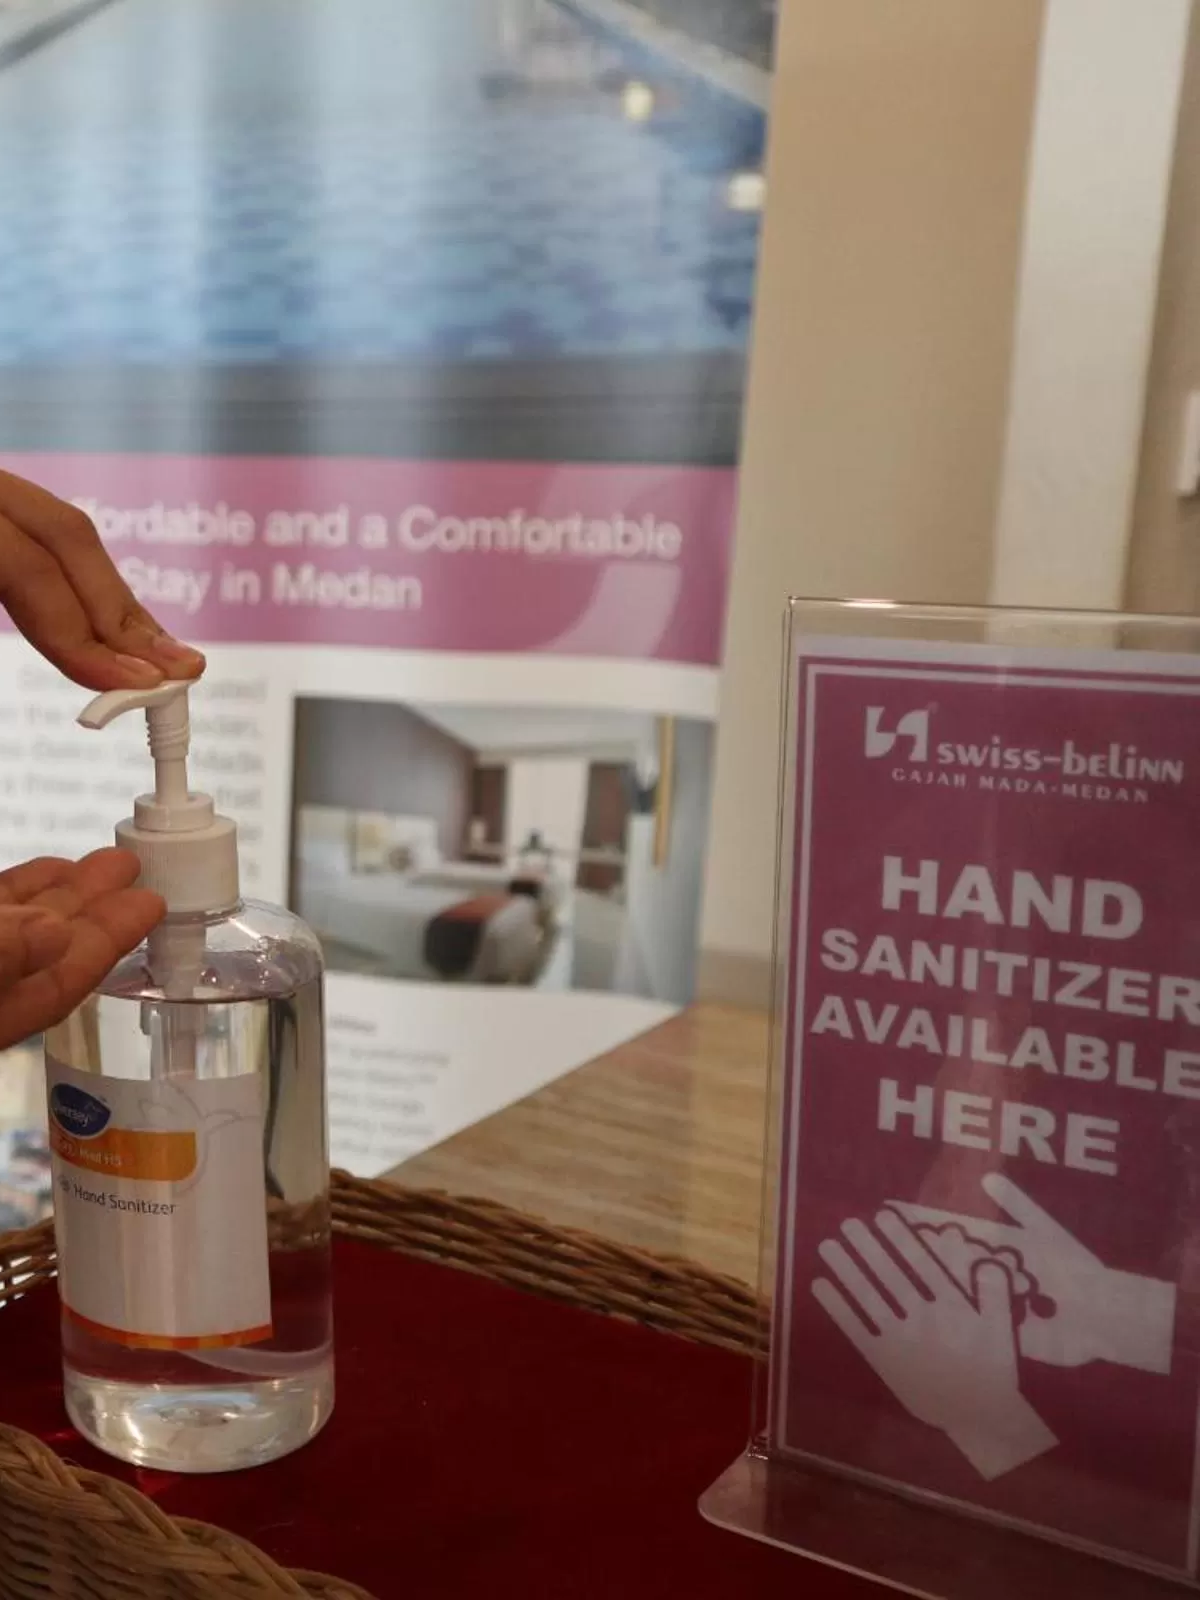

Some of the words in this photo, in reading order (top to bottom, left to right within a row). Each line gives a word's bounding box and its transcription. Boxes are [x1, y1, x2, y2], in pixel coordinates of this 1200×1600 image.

[264, 503, 349, 547] and
[358, 512, 388, 549] a
[399, 503, 682, 560] Comfortable
[118, 556, 211, 616] Stay
[220, 561, 261, 606] in
[271, 561, 423, 611] Medan
[891, 766, 966, 789] GAJAH
[881, 855, 1144, 940] HAND
[820, 928, 1200, 1027] SANITIZER
[810, 995, 1200, 1100] AVAILABLE
[877, 1078, 1120, 1177] HERE
[73, 1183, 106, 1206] Hand
[109, 1194, 176, 1216] Sanitizer
